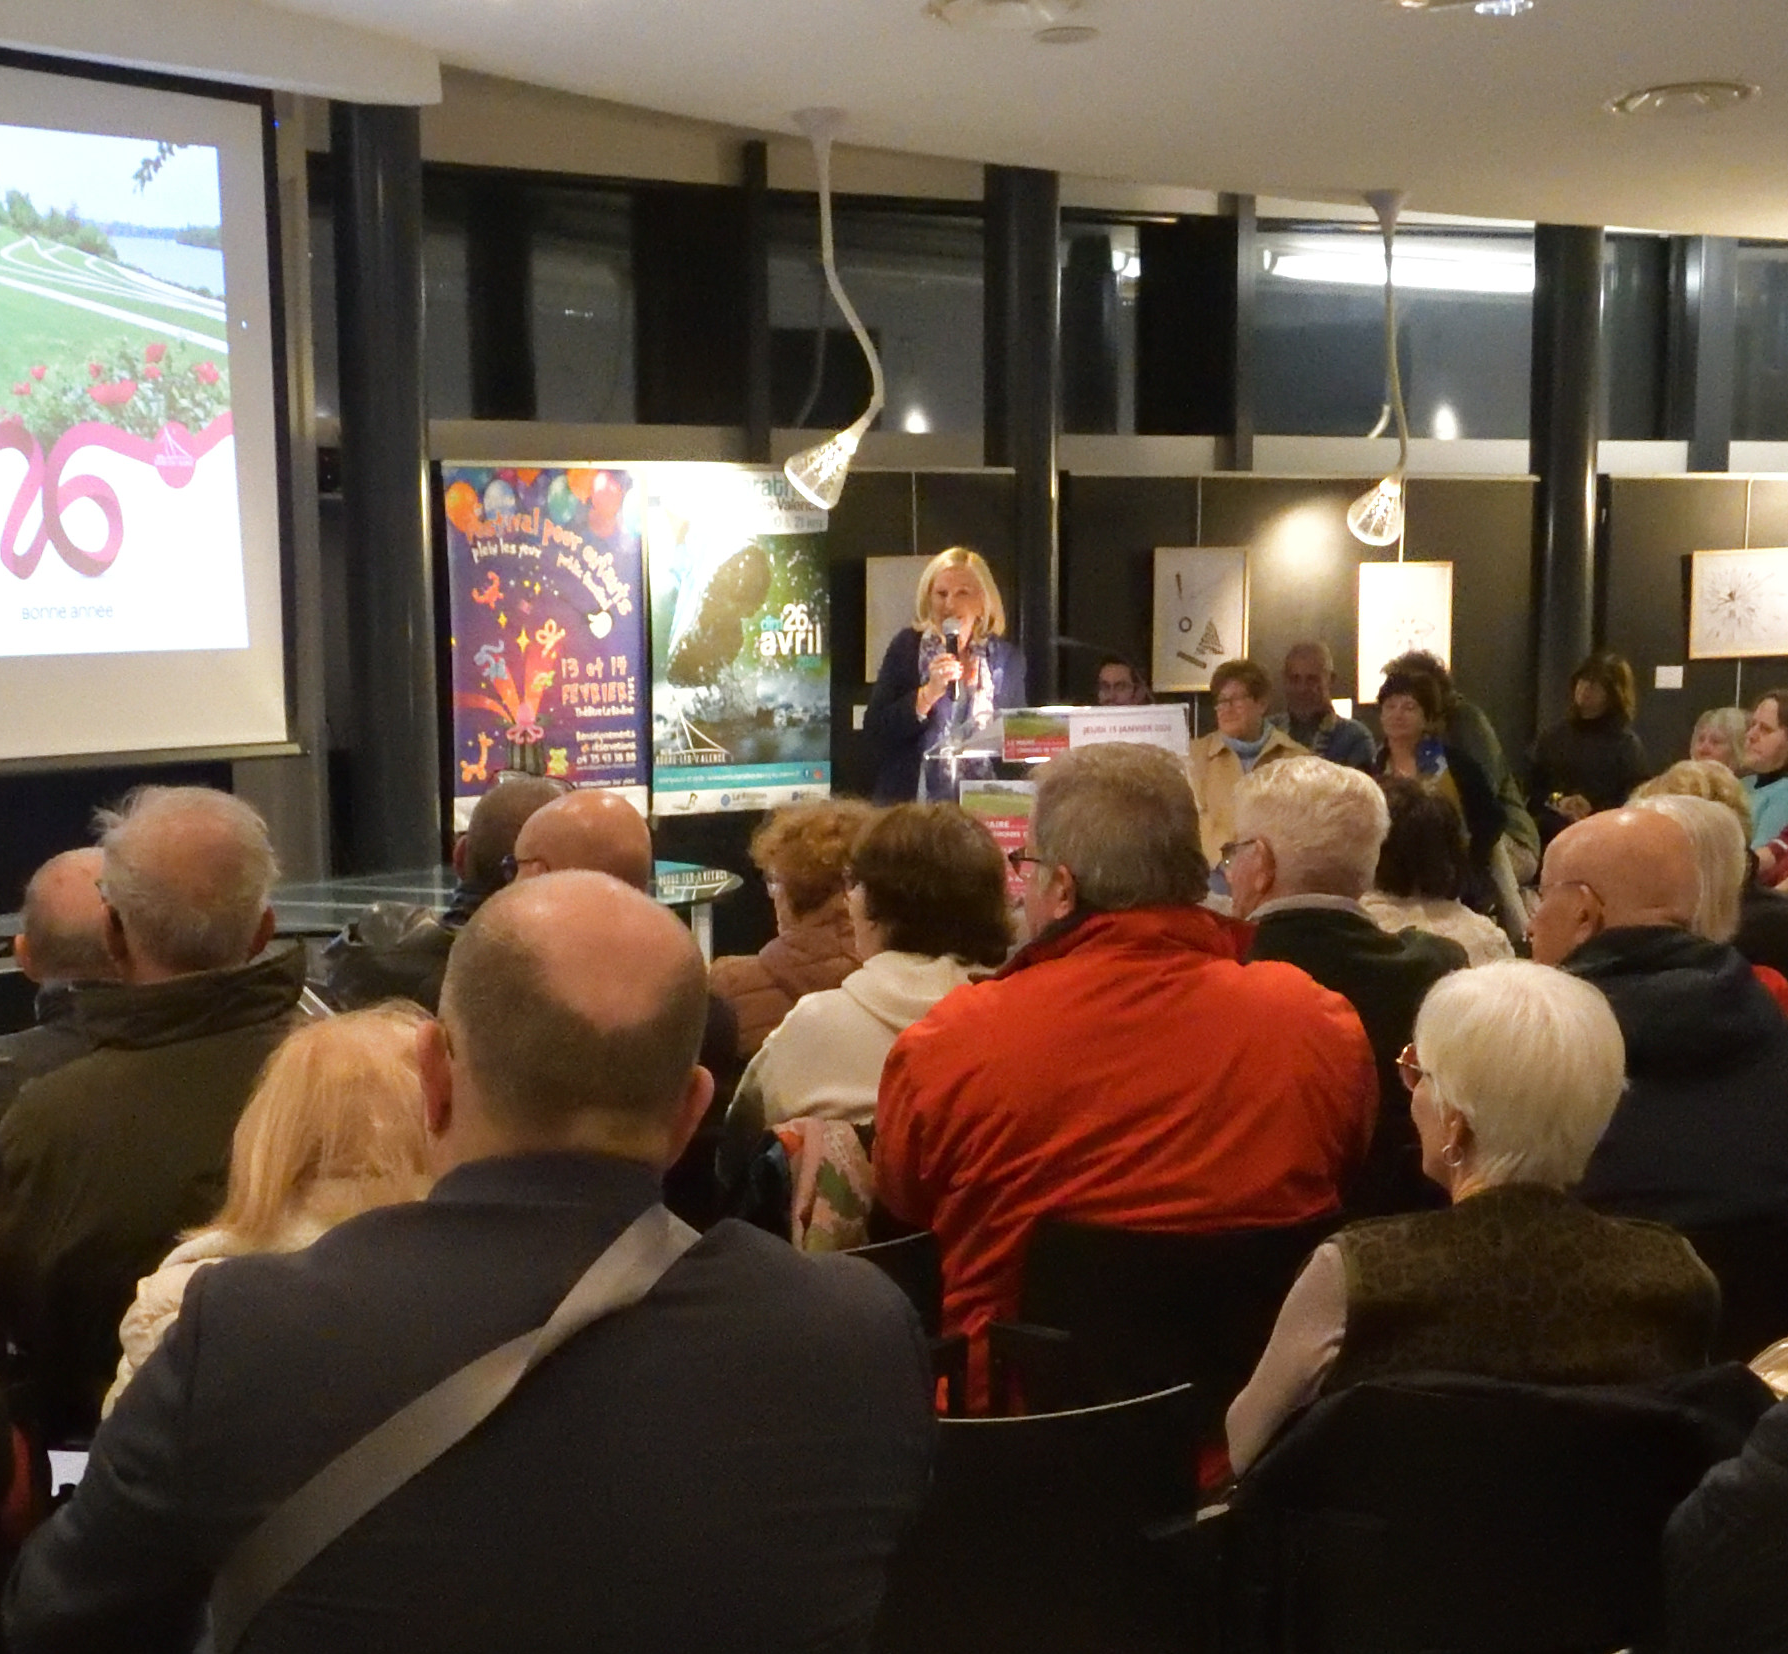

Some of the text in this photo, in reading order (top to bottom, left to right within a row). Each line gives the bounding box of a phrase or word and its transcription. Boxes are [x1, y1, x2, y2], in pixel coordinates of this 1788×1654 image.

[499, 537, 517, 556] les
[542, 518, 583, 550] pour
[782, 603, 809, 632] 26
[760, 622, 822, 656] avril
[561, 657, 580, 679] 13
[1119, 724, 1152, 734] JANVIER
